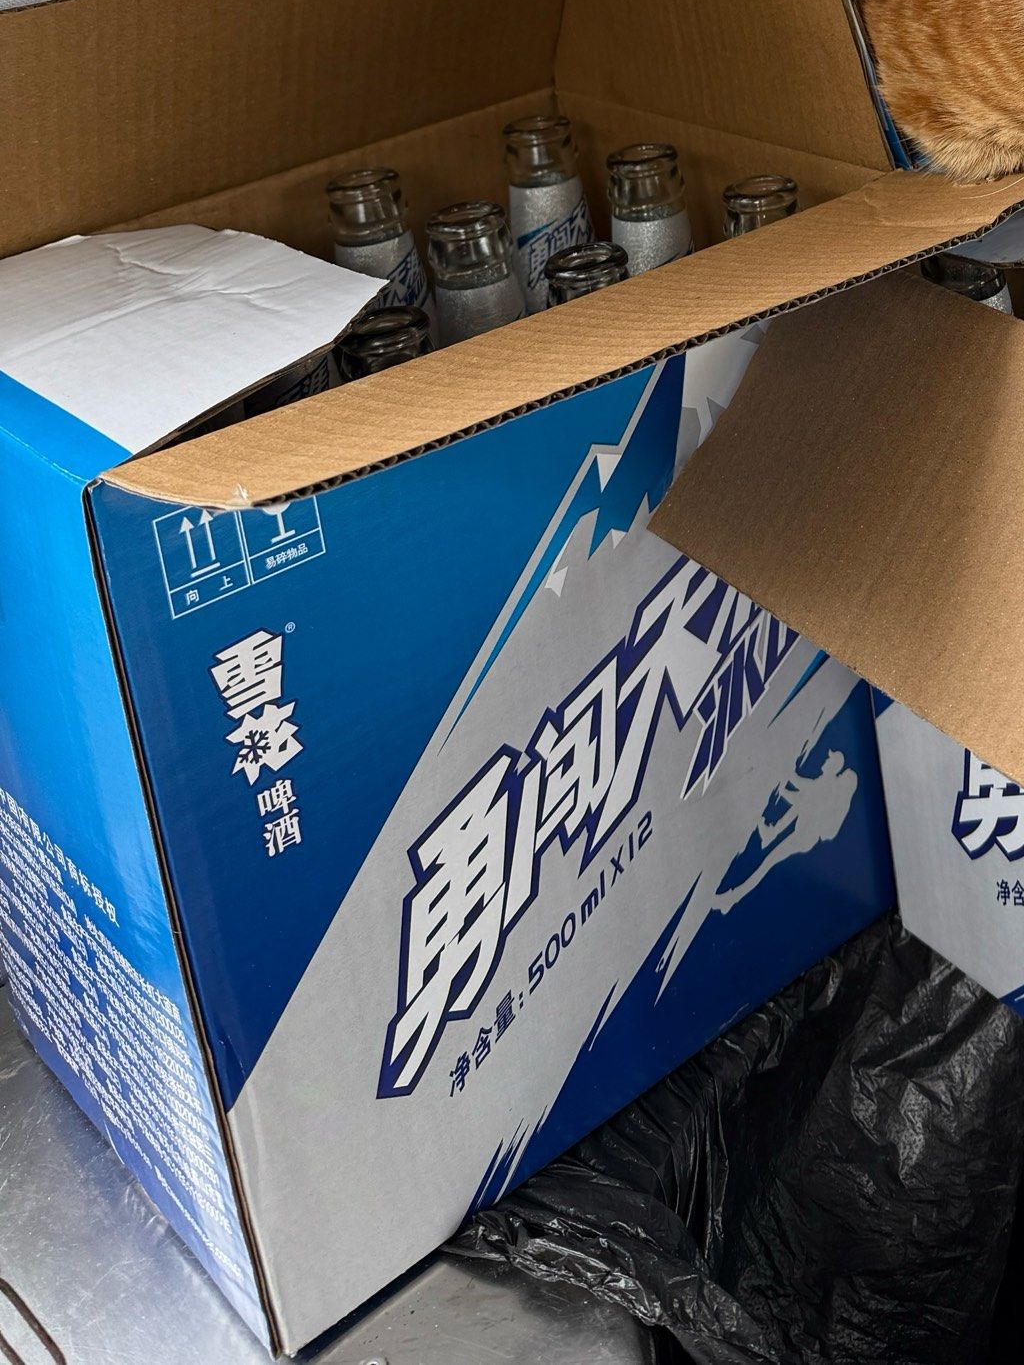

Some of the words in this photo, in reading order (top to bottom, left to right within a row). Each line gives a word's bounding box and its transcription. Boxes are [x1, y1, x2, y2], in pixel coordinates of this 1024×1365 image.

[266, 543, 309, 570] 易碎物品
[185, 589, 200, 605] 向
[219, 575, 234, 591] 上
[257, 778, 303, 857] 啤酒
